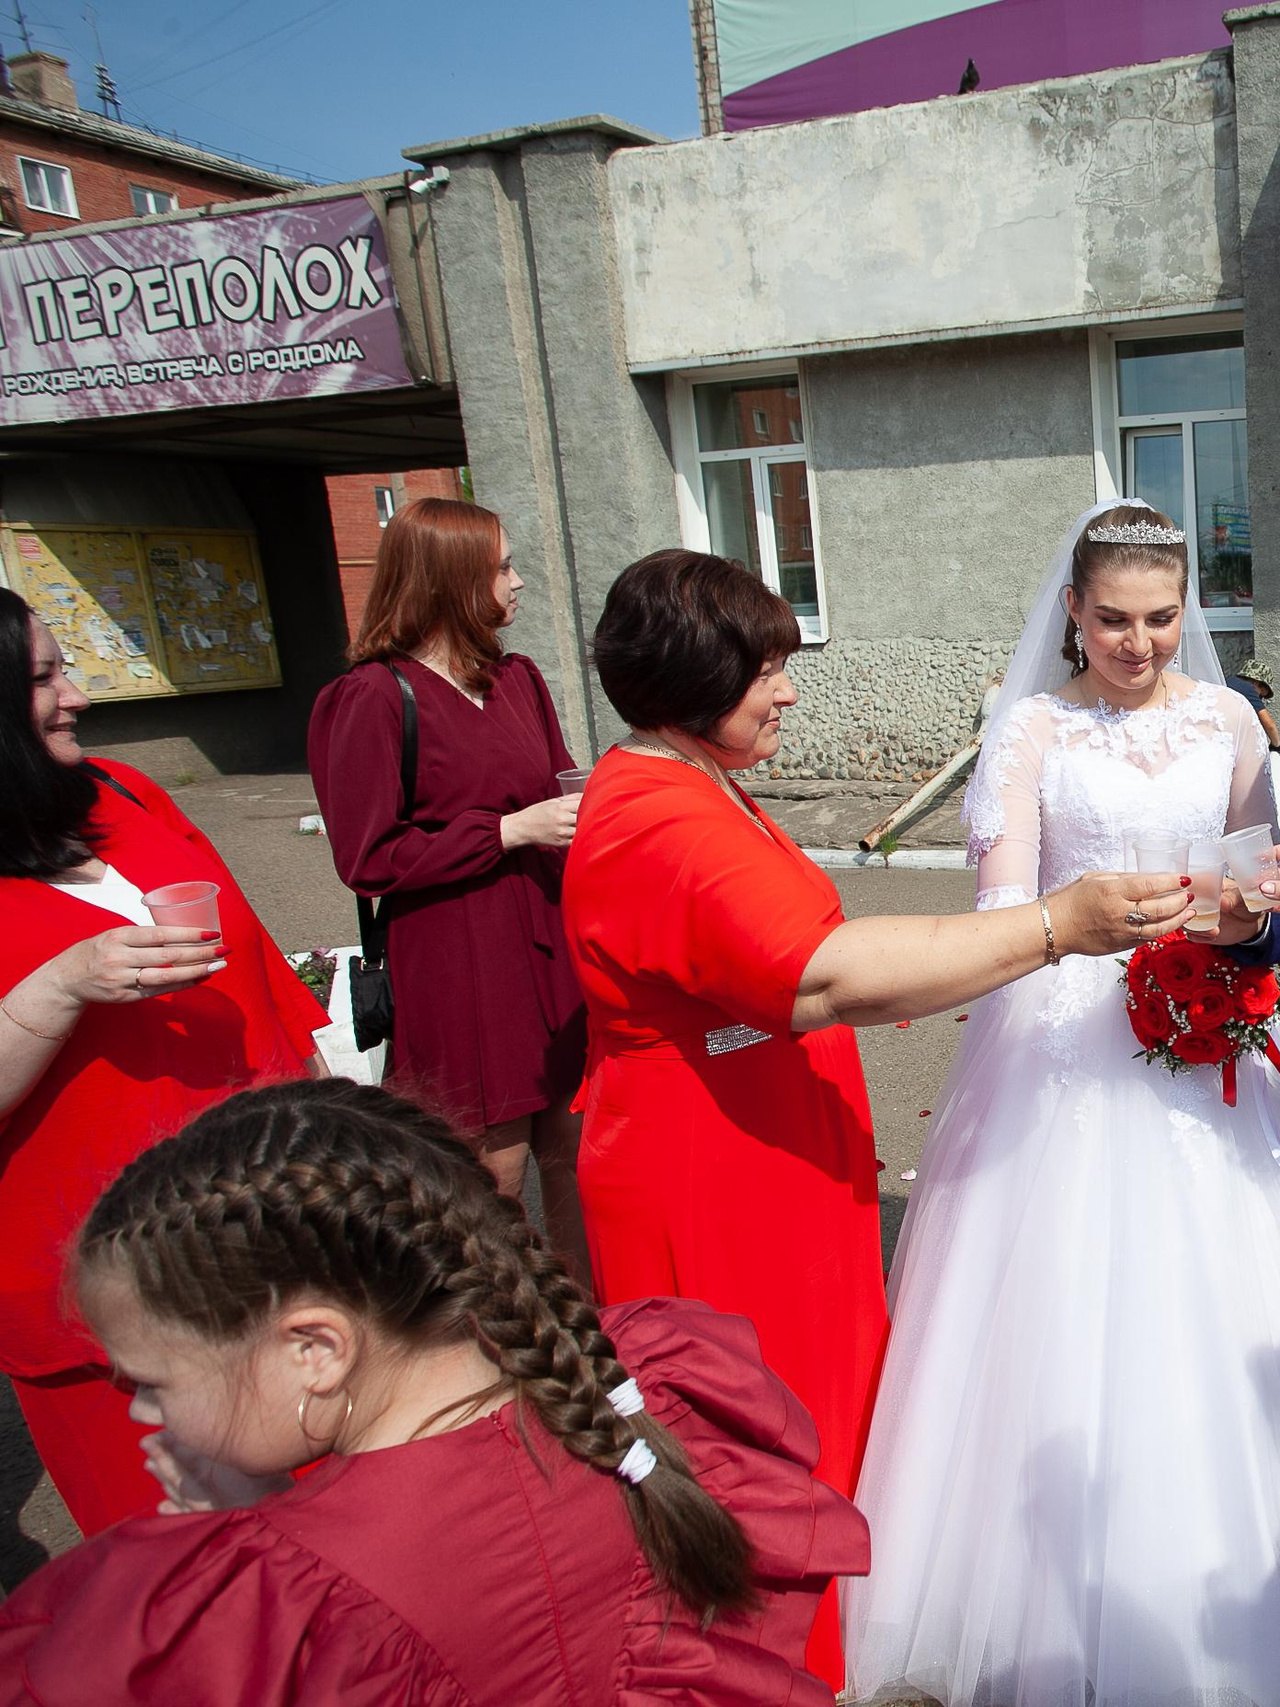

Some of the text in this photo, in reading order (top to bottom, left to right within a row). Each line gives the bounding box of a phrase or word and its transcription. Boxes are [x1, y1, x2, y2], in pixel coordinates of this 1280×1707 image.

[22, 234, 384, 346] ПЕРЕПОЛОХ
[2, 339, 364, 397] РОЖДЕНИЯ, ВСТРЕЧА С РОДДОМА
